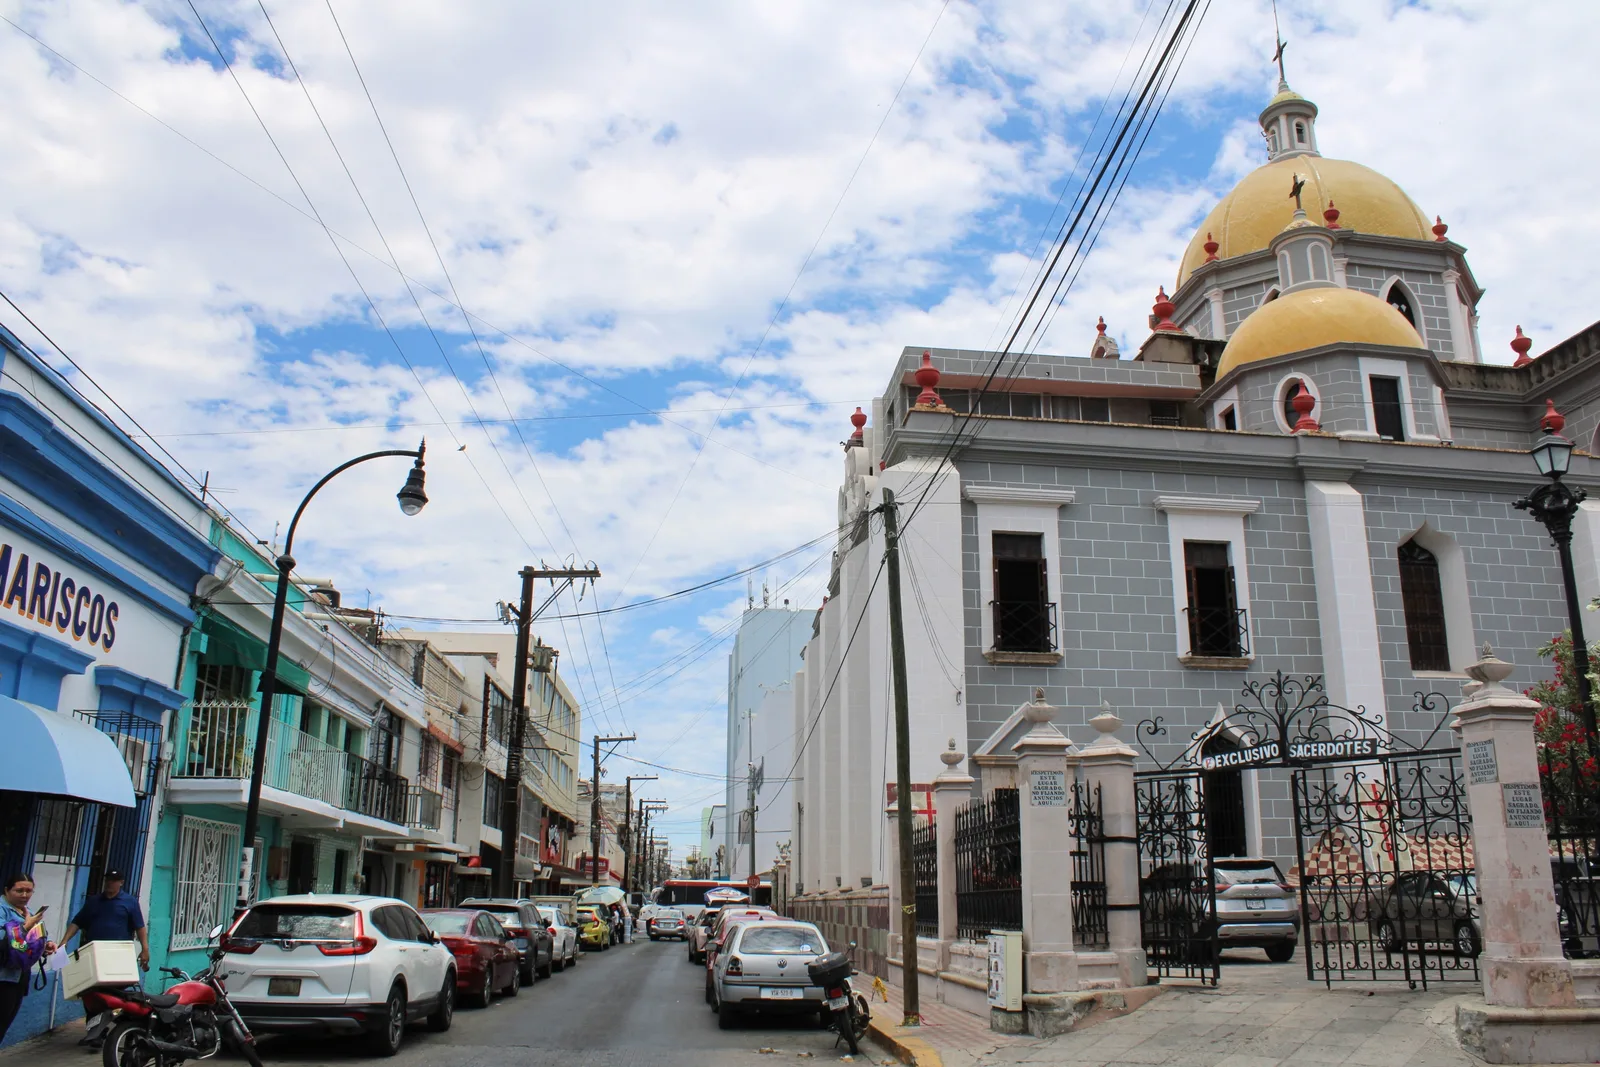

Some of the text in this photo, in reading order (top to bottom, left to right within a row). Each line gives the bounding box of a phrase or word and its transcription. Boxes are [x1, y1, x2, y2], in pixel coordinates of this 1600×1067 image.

[1474, 745, 1487, 753] ESTE
[1215, 743, 1280, 768] EXCLUSIVO
[1289, 740, 1372, 758] SACERDOTES
[1472, 752, 1489, 760] LUGAR
[1476, 763, 1496, 771] FIJANDO
[1471, 769, 1495, 778] ANUNCIOS
